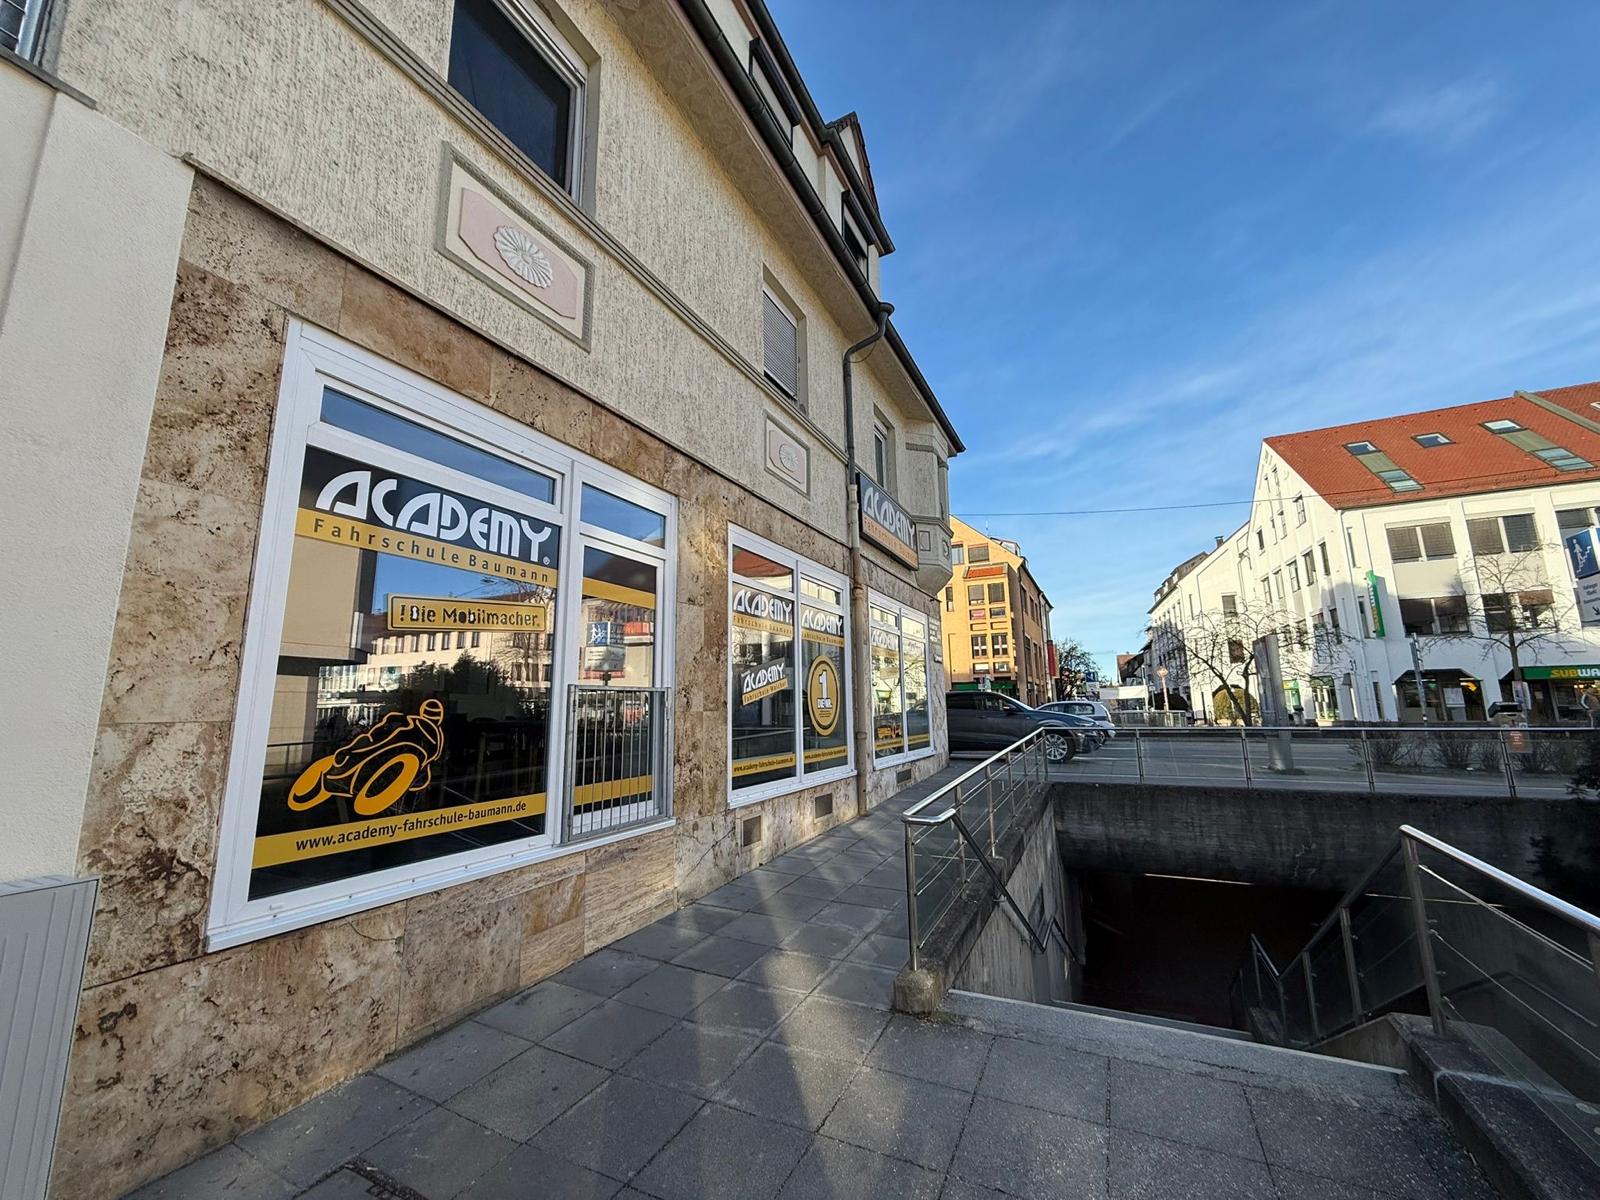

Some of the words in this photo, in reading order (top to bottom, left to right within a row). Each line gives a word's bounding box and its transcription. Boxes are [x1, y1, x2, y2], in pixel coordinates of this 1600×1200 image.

[315, 470, 551, 562] ACADEMY
[864, 487, 915, 549] ACADEMY
[313, 518, 459, 564] Fahrschule
[469, 554, 548, 583] Baumann
[734, 589, 792, 622] ACADEMY
[801, 609, 843, 636] ACADEMY
[743, 663, 785, 694] ACADEMY
[296, 802, 526, 851] www.academy-fahrschule-baumann.de
